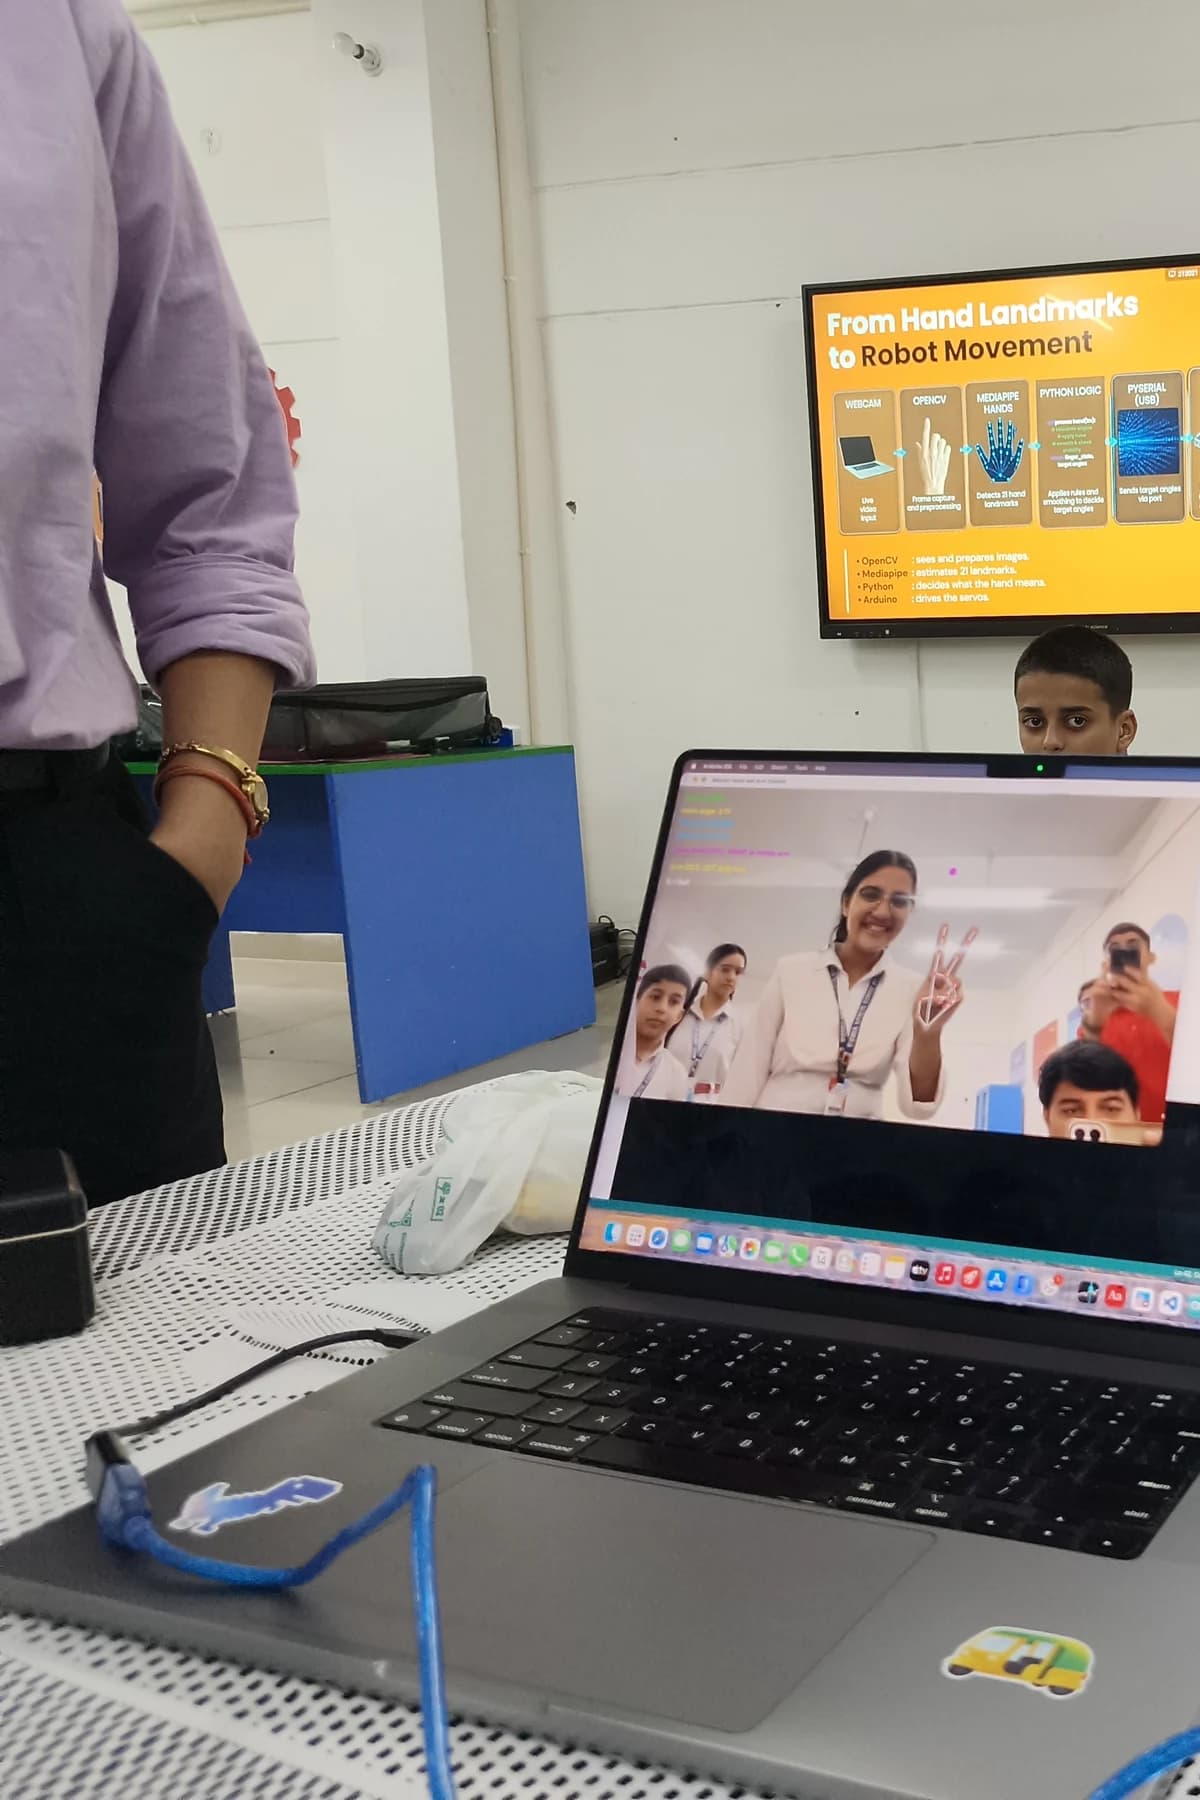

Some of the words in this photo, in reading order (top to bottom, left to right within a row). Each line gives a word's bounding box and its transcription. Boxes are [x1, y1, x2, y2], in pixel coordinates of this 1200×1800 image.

[665, 244, 718, 265] HOW
[827, 312, 895, 337] From
[901, 302, 974, 332] Hand
[979, 292, 1139, 327] Landmarks
[828, 346, 856, 370] to
[861, 340, 938, 367] Robot
[944, 330, 1093, 363] Movement
[1039, 387, 1074, 398] PYTHON
[1075, 385, 1102, 396] LOGIC
[1127, 382, 1167, 395] PYSERIAL
[913, 395, 947, 406] OPENCV
[976, 392, 1020, 403] MEDIAPIPE
[1135, 394, 1160, 407] (USB)
[844, 399, 882, 409] WEBCAM
[983, 403, 1013, 414] HANDS
[976, 491, 1000, 500] Detects
[1009, 490, 1026, 499] hand
[1048, 489, 1070, 498] Applies
[1071, 488, 1085, 496] rules
[1086, 488, 1099, 496] and
[1119, 487, 1139, 495] Sends
[1139, 486, 1159, 496] target
[1159, 485, 1182, 495] angles
[912, 495, 931, 504] Frame
[931, 495, 956, 504] capture
[984, 500, 1019, 508] landmarks
[1043, 497, 1075, 507] smoothing
[1076, 497, 1084, 505] to
[1084, 495, 1104, 505] decide
[1138, 495, 1148, 503] via
[1148, 495, 1163, 505] port
[907, 504, 920, 512] and
[919, 503, 962, 513] preprocessing
[1054, 506, 1073, 515] target
[1073, 505, 1094, 514] angles
[861, 556, 898, 567] OpenCV
[916, 556, 936, 564] sees
[937, 555, 954, 564] and
[955, 553, 994, 566] prepares
[996, 552, 1029, 563] images.
[862, 569, 908, 579] Mediapipe
[916, 568, 958, 577] estimates
[969, 565, 1017, 576] landmarks.
[862, 582, 893, 593] Python
[916, 580, 950, 590] decides
[951, 579, 974, 589] what
[975, 579, 990, 588] the
[992, 578, 1013, 588] hand
[1015, 579, 1046, 588] means.
[863, 595, 897, 604] Arduino
[916, 593, 942, 603] drives
[943, 593, 958, 602] the
[959, 593, 989, 602] servos.
[1108, 1290, 1122, 1302] Aa
[436, 1424, 469, 1433] control
[529, 1441, 574, 1452] command
[845, 1495, 896, 1508] command
[914, 1507, 948, 1517] option
